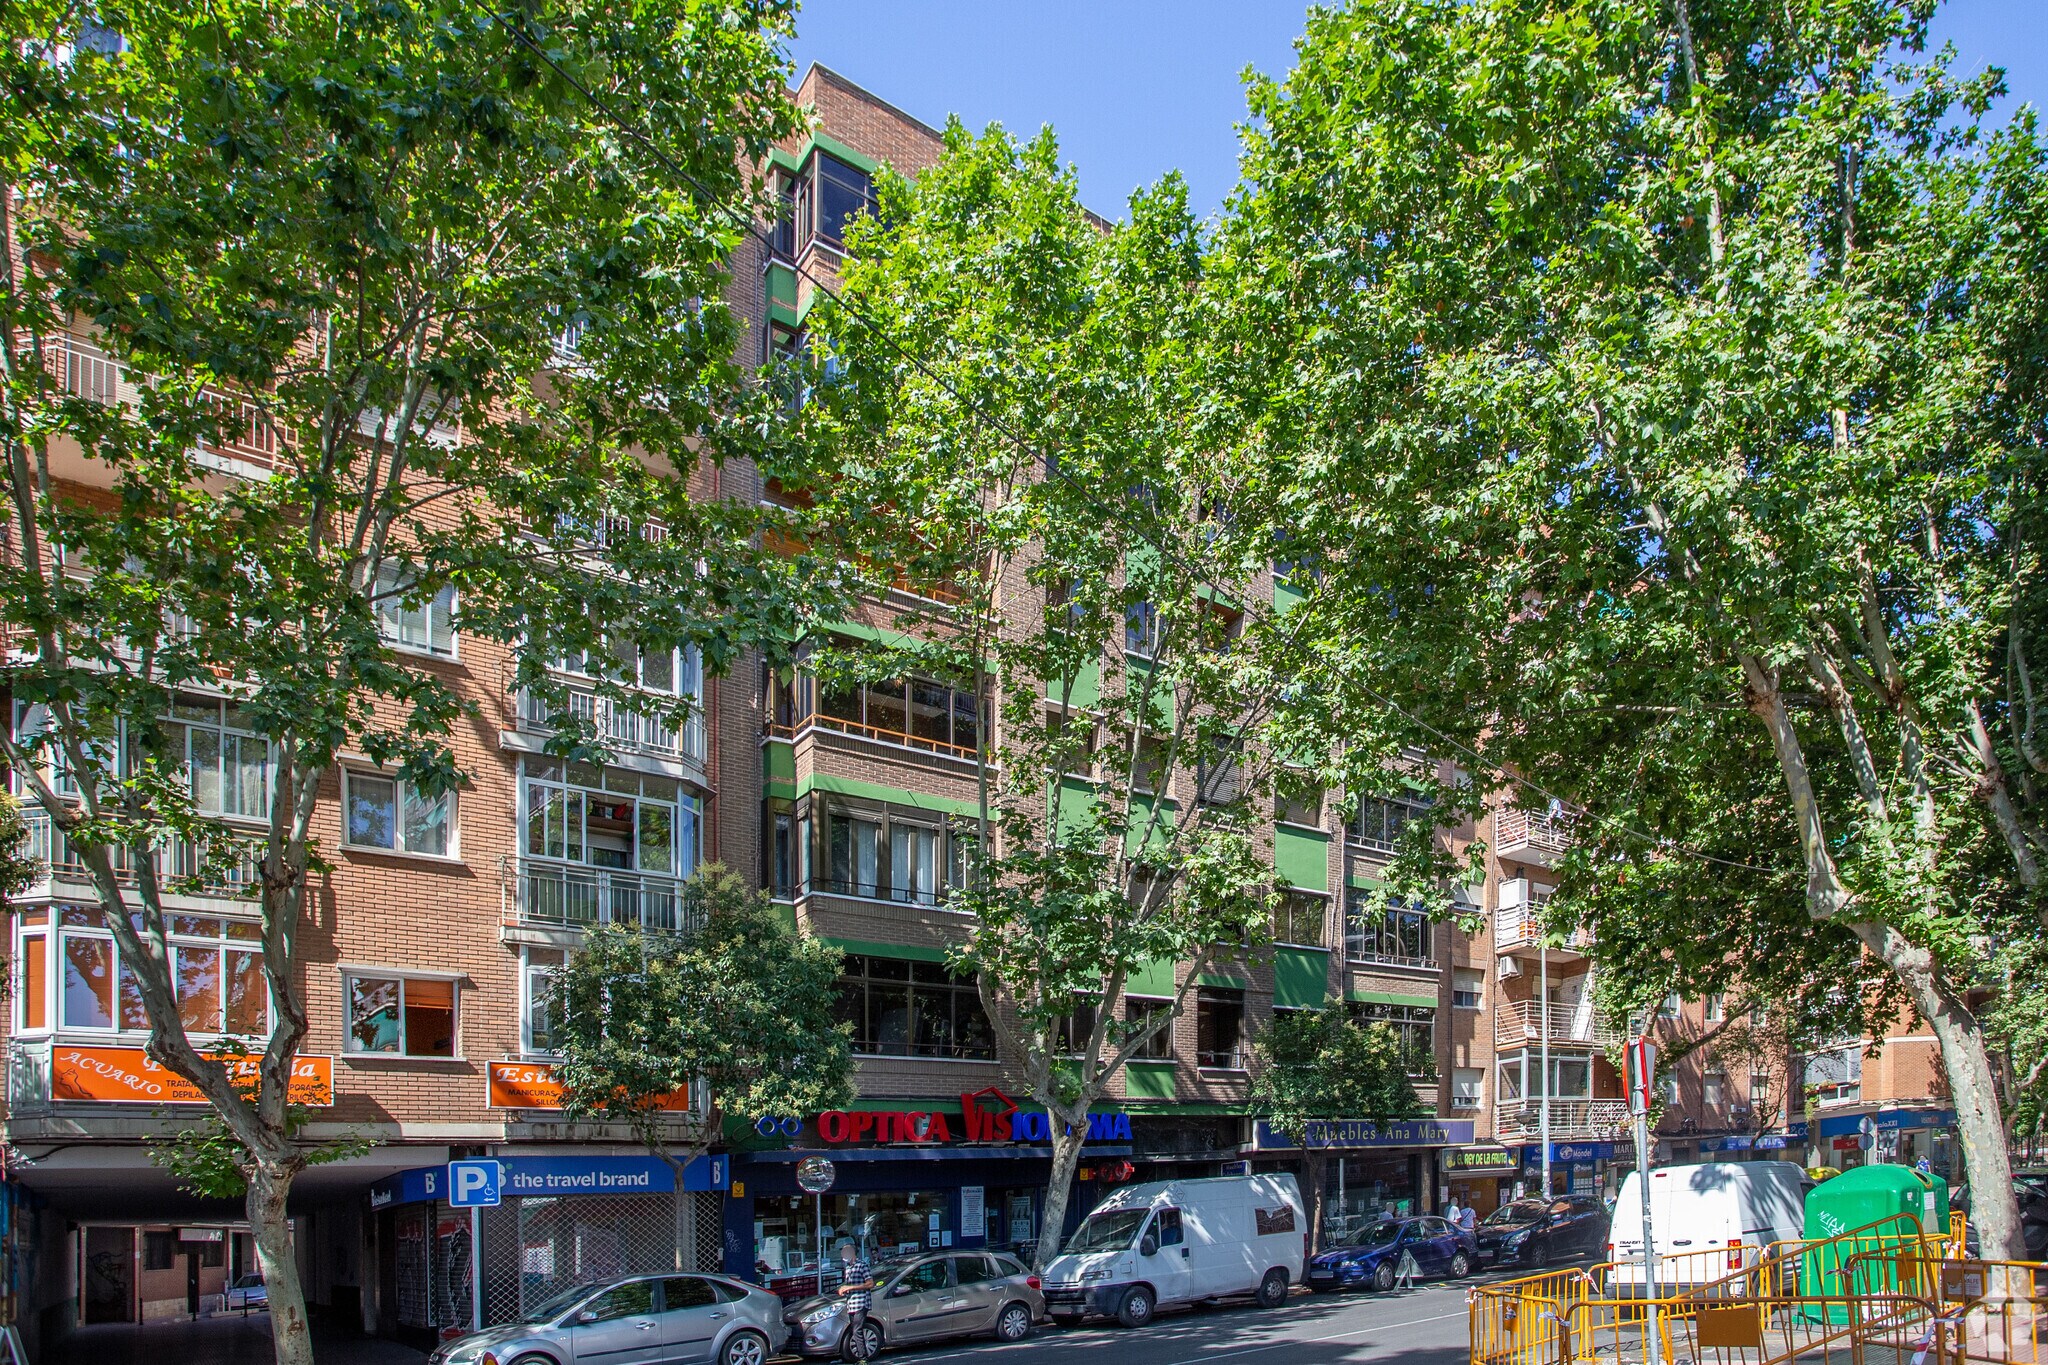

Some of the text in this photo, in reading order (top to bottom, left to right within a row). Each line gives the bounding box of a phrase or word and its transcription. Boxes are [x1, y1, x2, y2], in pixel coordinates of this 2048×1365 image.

[60, 1051, 162, 1095] ACUARIO
[166, 1079, 197, 1088] TRATA
[172, 1090, 206, 1099] DEPILAC
[507, 1088, 555, 1098] MANICURAS
[961, 1092, 1133, 1142] VISIOMA
[817, 1110, 950, 1143] OPTICA
[1315, 1123, 1450, 1143] Muebles Ana Mary
[1613, 1143, 1635, 1154] MARTI
[457, 1166, 488, 1202] P
[513, 1172, 544, 1188] the
[546, 1171, 596, 1188] travel
[599, 1171, 649, 1187] brand
